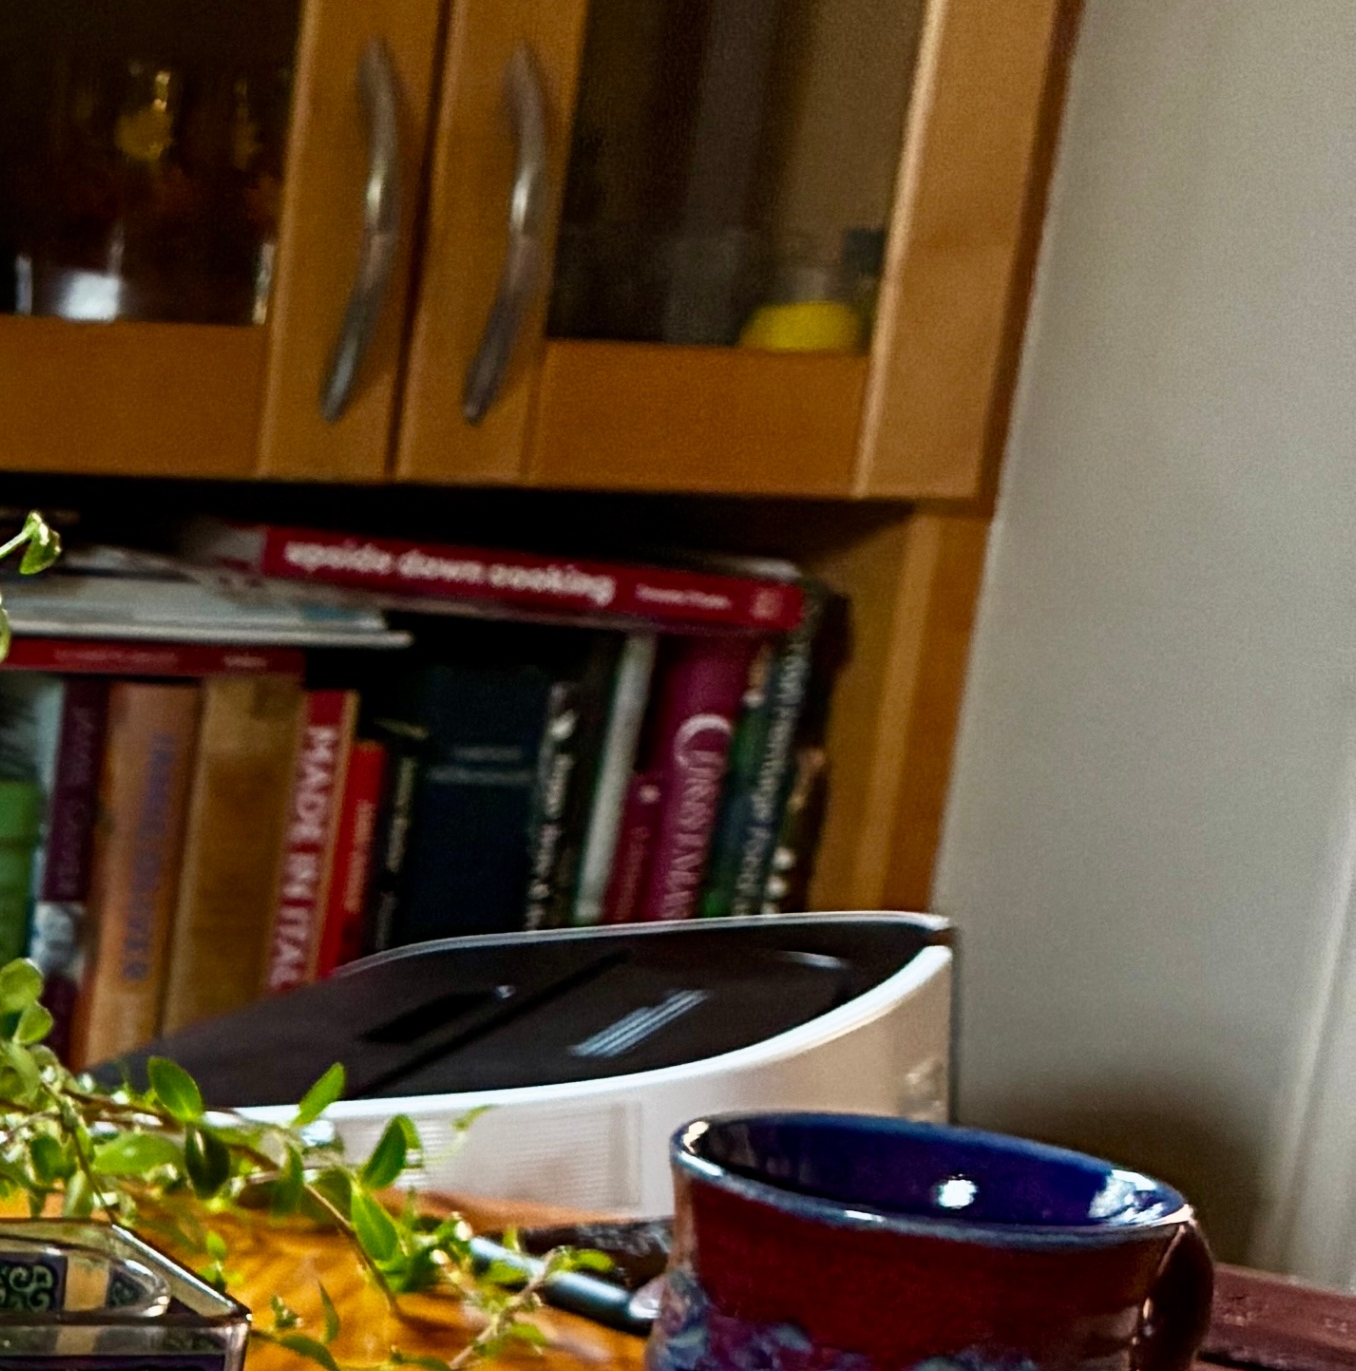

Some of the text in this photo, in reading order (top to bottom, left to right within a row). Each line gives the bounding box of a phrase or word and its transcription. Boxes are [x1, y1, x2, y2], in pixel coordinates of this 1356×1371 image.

[284, 539, 391, 575] upside
[396, 549, 485, 584] down
[488, 563, 616, 607] cooking
[287, 724, 337, 846] MADE
[282, 850, 321, 901] IN
